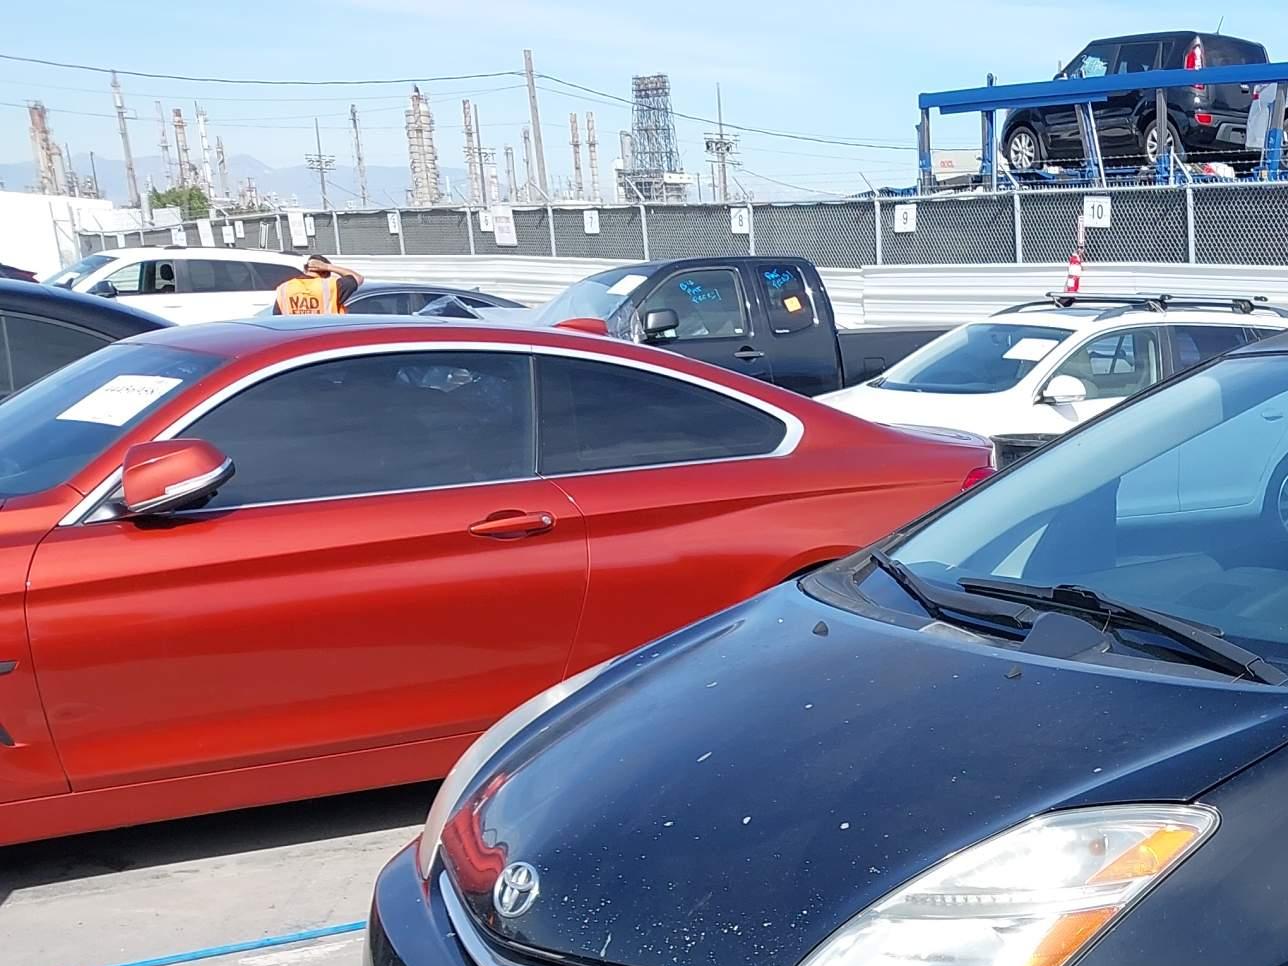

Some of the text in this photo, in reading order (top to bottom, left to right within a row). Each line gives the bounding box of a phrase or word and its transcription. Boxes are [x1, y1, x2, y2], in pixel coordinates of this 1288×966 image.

[902, 211, 908, 225] 9
[1091, 204, 1103, 220] 10
[738, 214, 744, 227] 8
